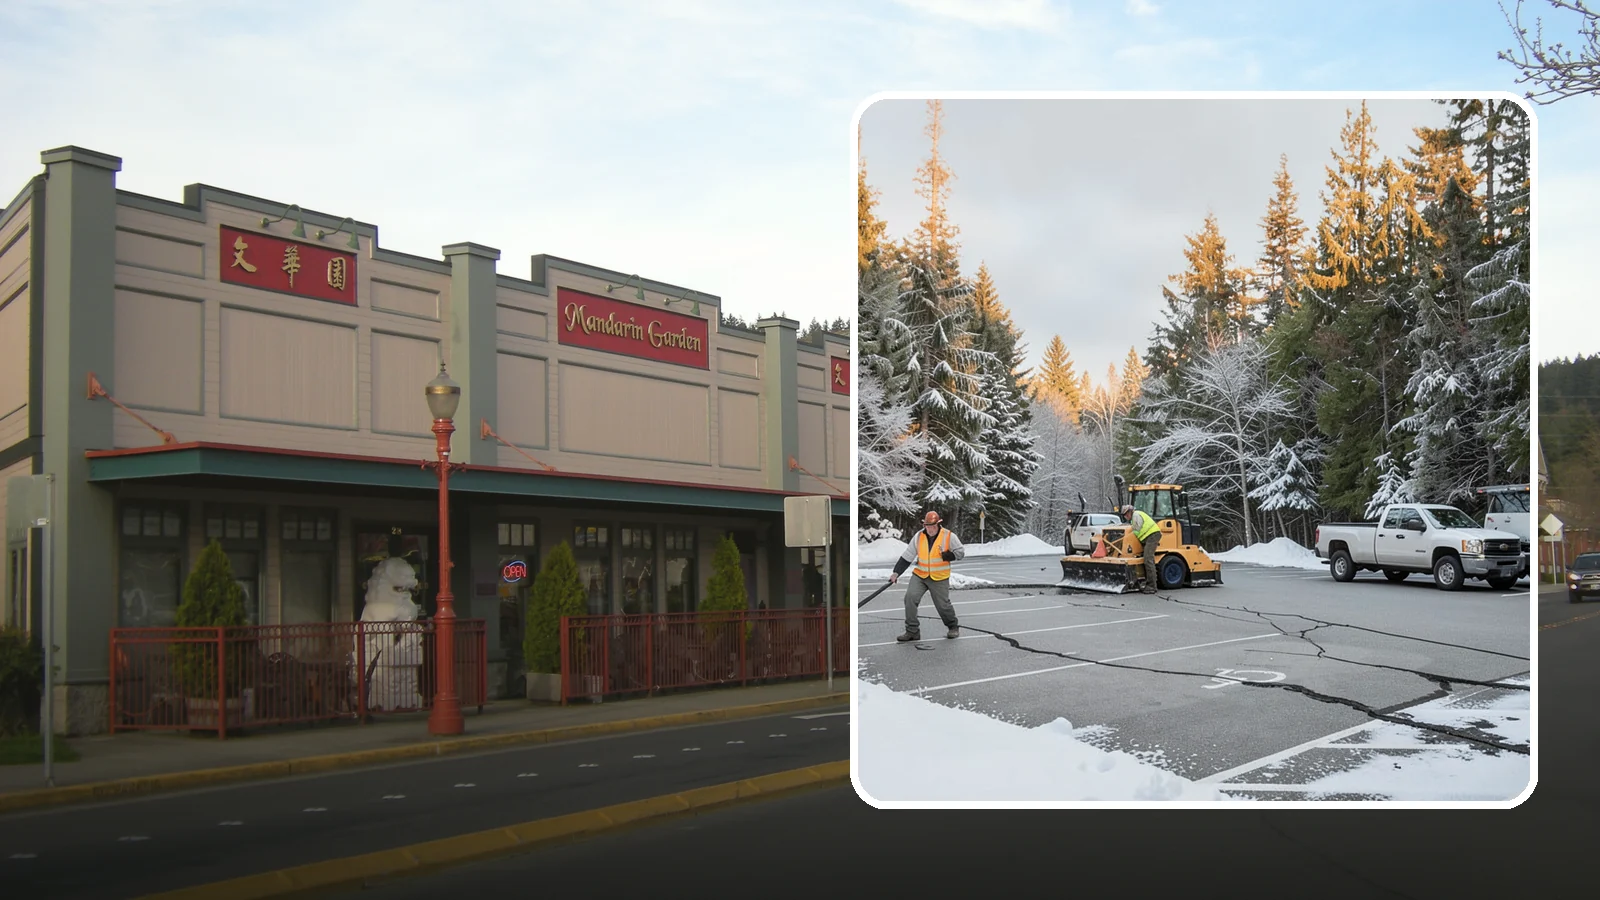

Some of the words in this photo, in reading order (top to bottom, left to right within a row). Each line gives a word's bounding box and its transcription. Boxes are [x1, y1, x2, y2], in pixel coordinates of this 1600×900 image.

[564, 302, 644, 341] Mandarin
[647, 320, 702, 352] Garden
[503, 565, 527, 578] OPEN
